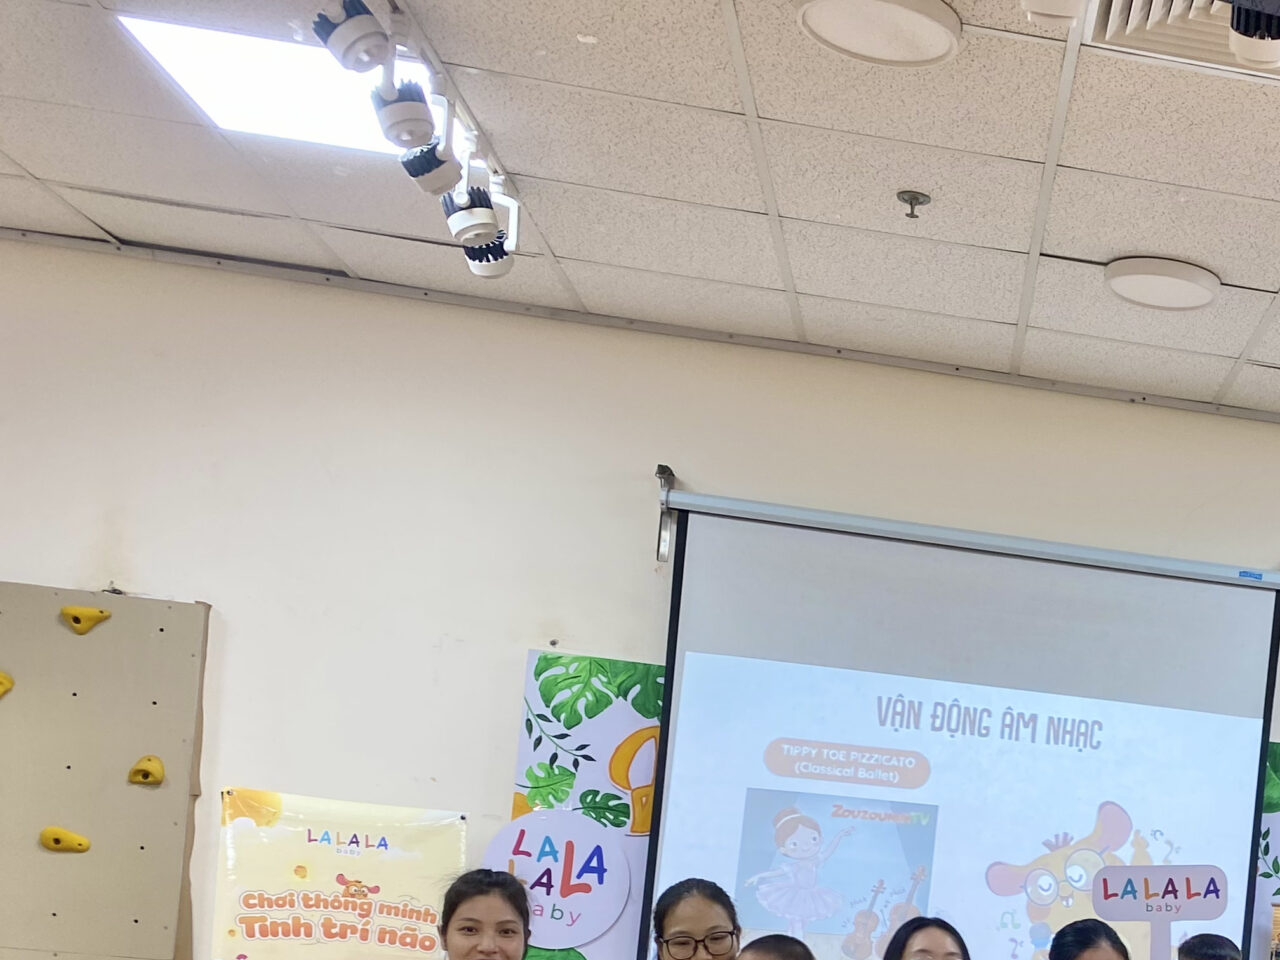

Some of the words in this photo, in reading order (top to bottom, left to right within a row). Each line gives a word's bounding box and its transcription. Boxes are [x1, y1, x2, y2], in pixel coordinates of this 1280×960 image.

[877, 694, 922, 732] VẬN
[930, 698, 992, 738] ĐỘNG
[1000, 706, 1038, 743] ÂM
[1046, 716, 1103, 752] NHẠC
[782, 744, 819, 758] TIPPY
[823, 749, 846, 761] TOE
[850, 752, 916, 768] PIZZICATO
[794, 762, 856, 777] (Classical
[858, 767, 900, 784] Ballet)
[379, 902, 438, 924] minh
[532, 903, 582, 927] aby
[1146, 902, 1182, 914] baby
[321, 918, 370, 942] trí
[378, 927, 436, 952] não
